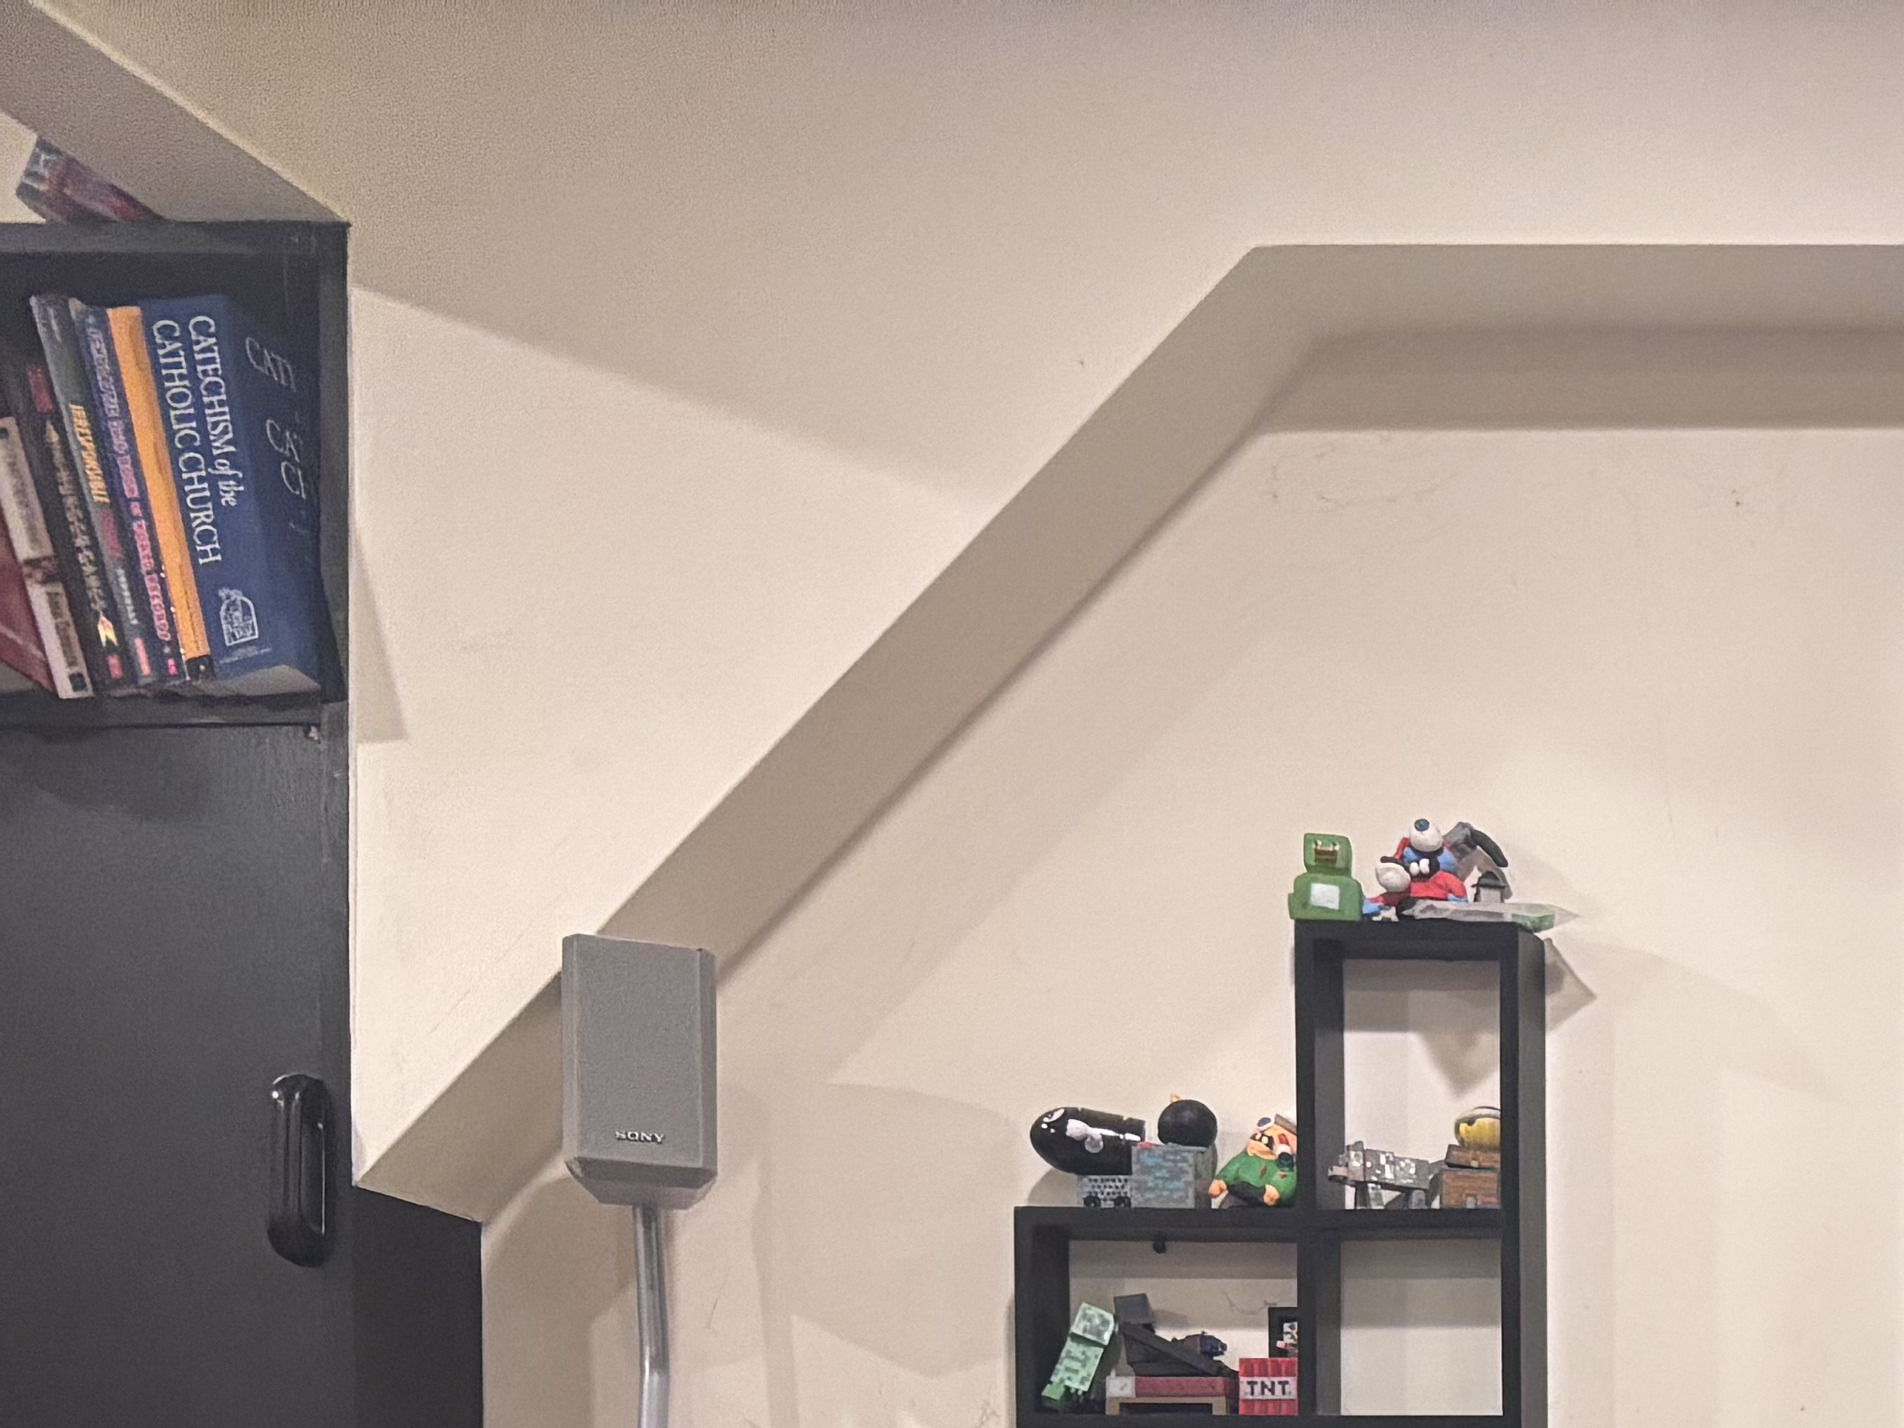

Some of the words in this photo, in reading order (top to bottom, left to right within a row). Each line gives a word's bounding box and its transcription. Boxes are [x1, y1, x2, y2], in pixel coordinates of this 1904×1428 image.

[186, 314, 238, 455] CATECHISM
[150, 318, 201, 449] CATHOLIC
[176, 450, 223, 565] CHURCH
[212, 458, 239, 477] of
[220, 479, 243, 506] the
[615, 1130, 665, 1144] SONY
[1247, 1381, 1289, 1397] TNT
